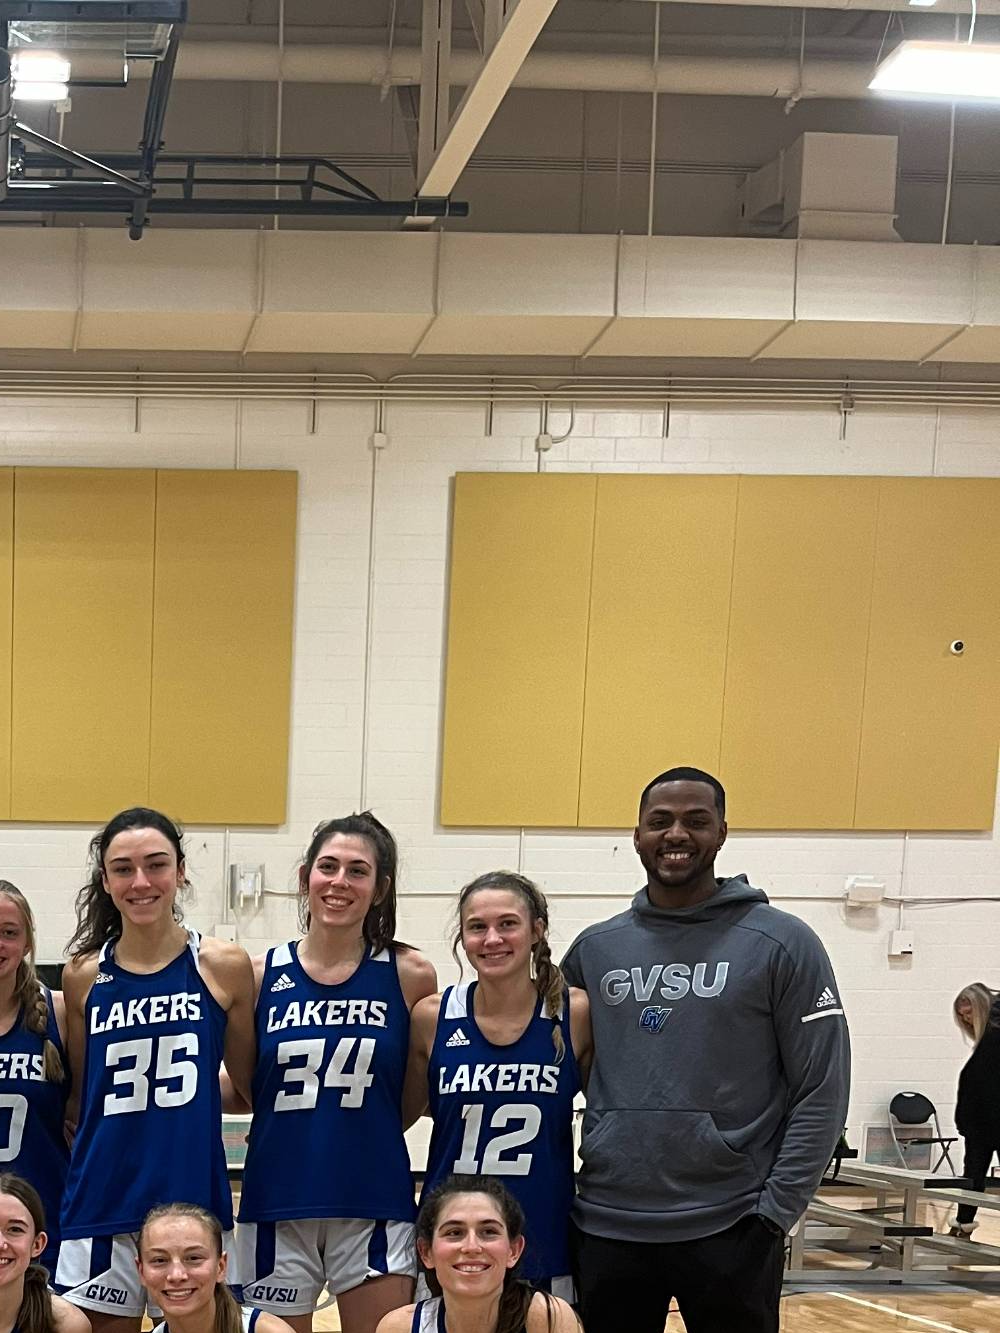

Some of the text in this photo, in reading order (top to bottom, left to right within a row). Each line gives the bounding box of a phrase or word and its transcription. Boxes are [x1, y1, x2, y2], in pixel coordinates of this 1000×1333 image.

[600, 961, 730, 1006] GVSU
[90, 992, 201, 1035] LAKERS
[266, 999, 388, 1034] LAKERS
[103, 1032, 199, 1117] 35
[273, 1037, 377, 1113] 34
[438, 1063, 561, 1095] LAKERS
[452, 1103, 542, 1176] 12
[85, 1284, 128, 1305] GVSU
[252, 1285, 298, 1303] GVSU
